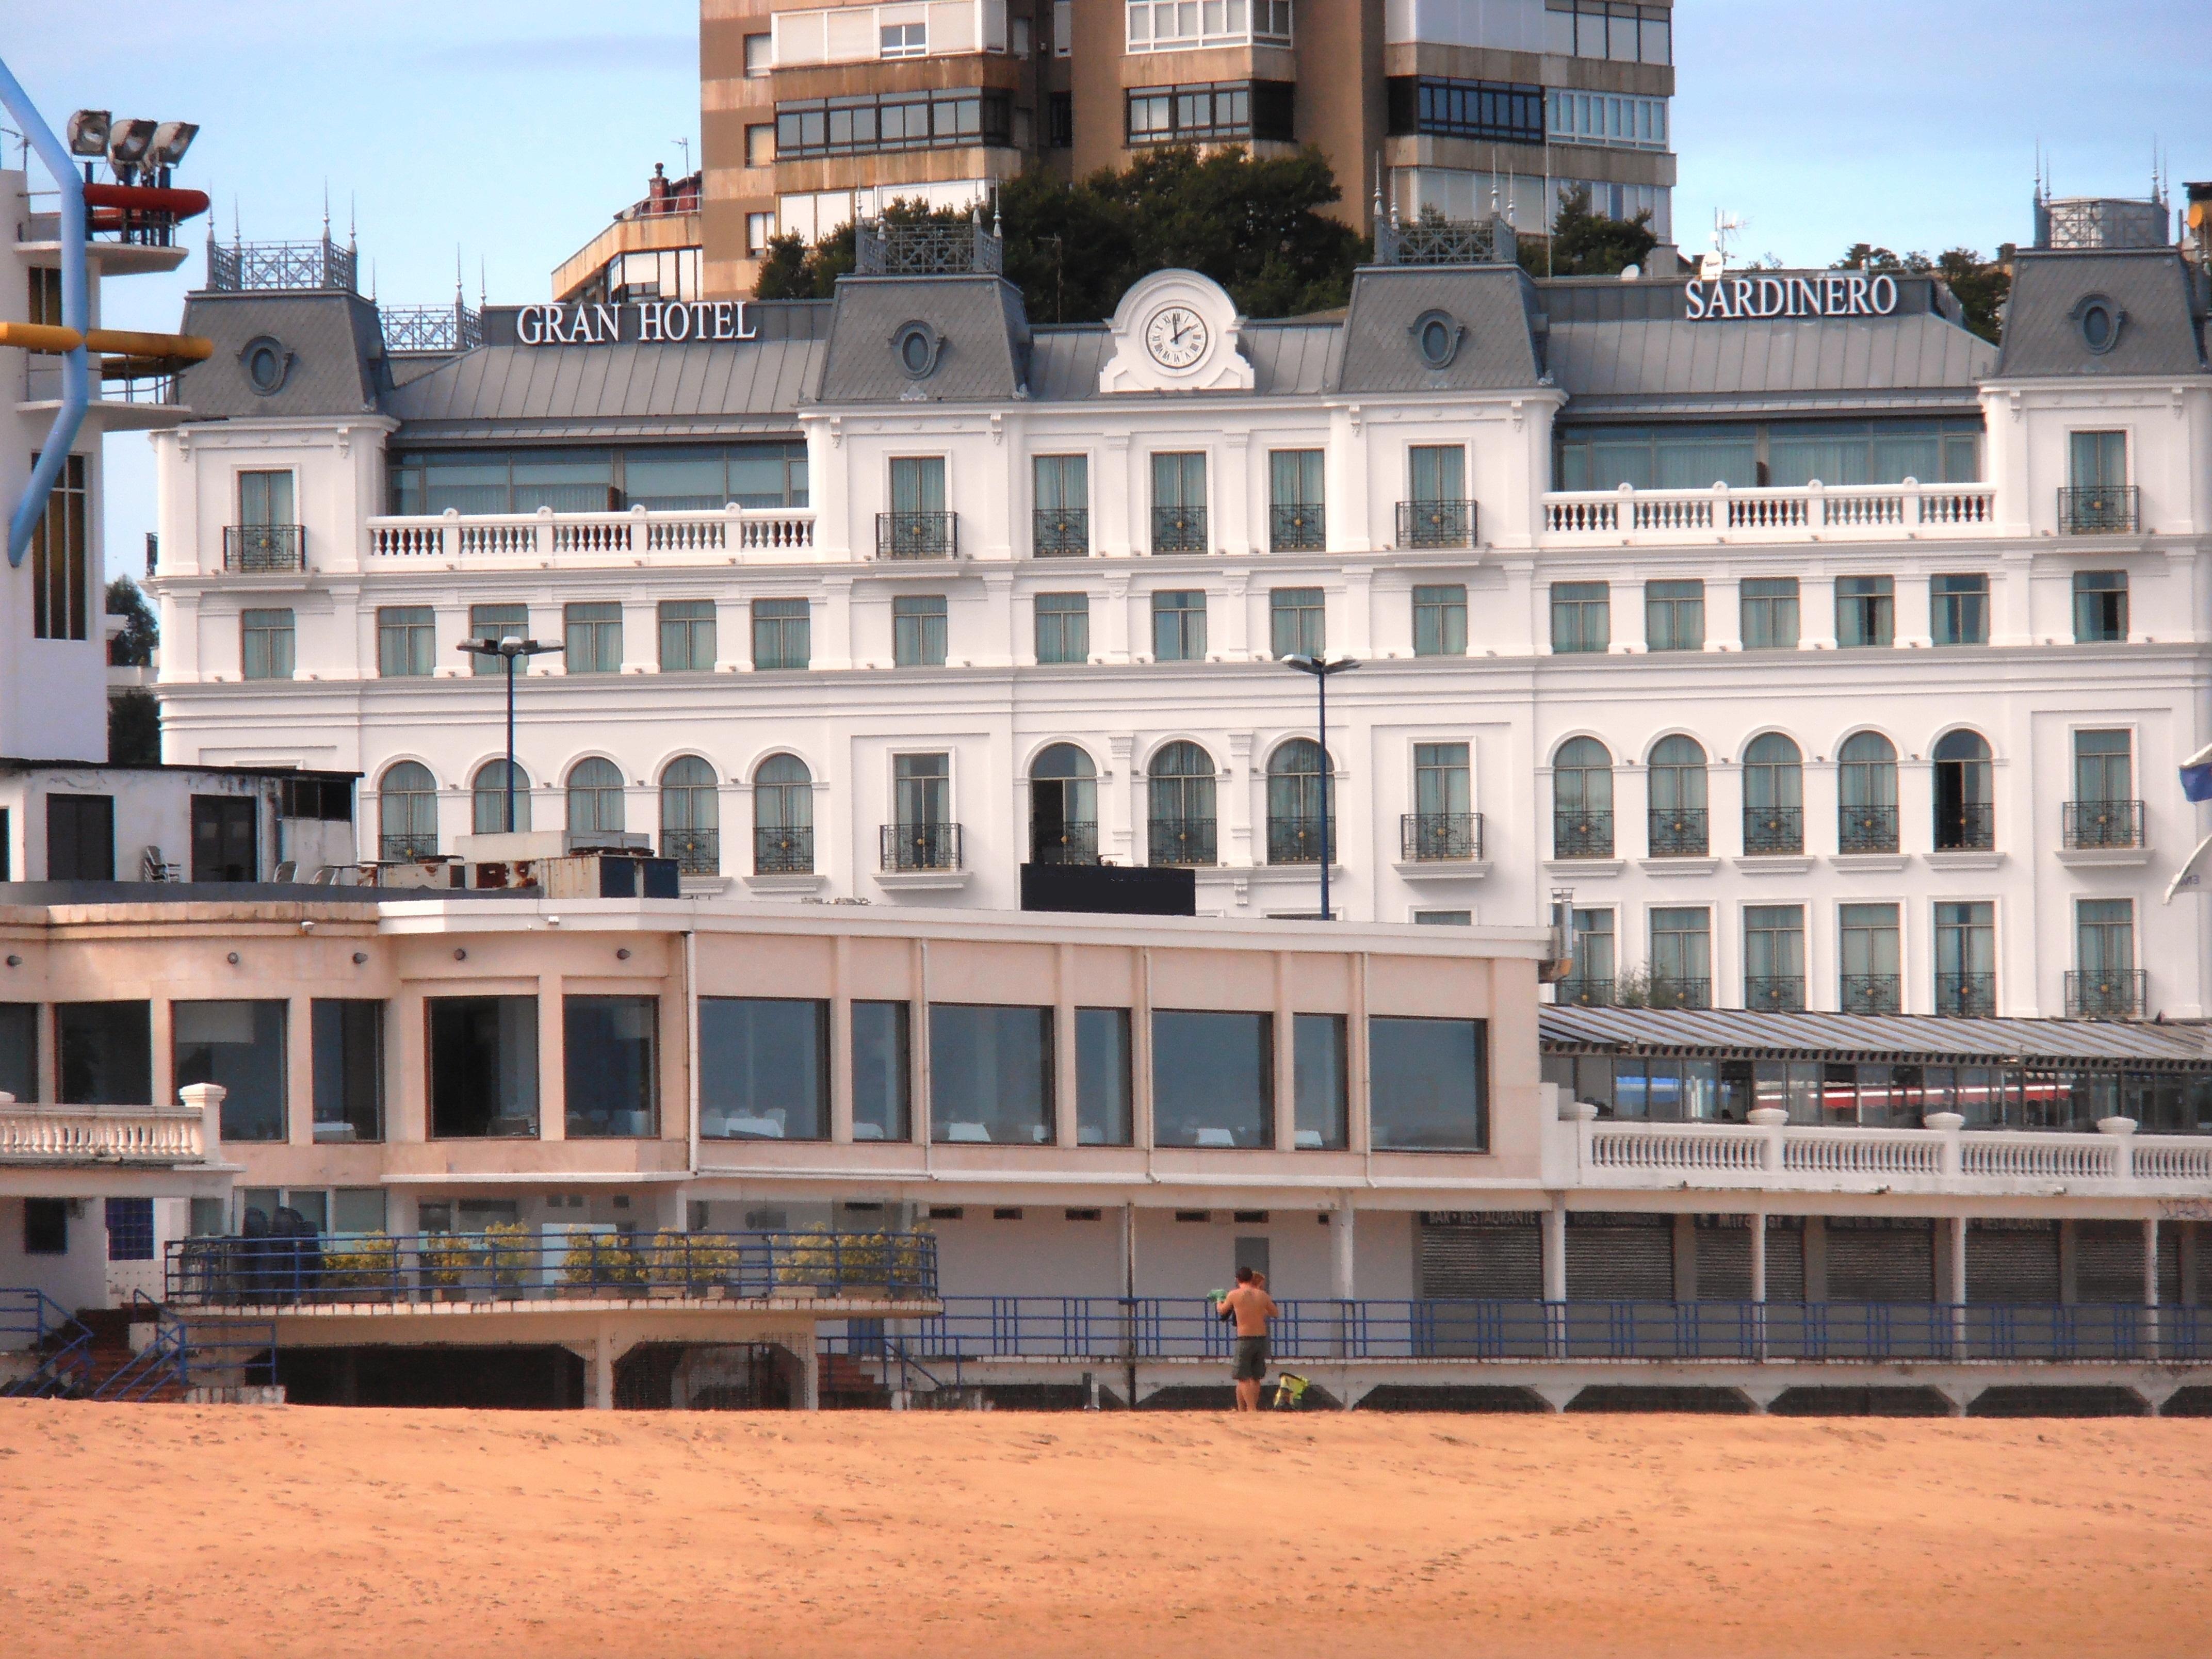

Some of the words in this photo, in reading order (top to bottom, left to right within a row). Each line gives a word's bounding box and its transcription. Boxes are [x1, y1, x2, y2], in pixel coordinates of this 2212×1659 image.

[1685, 274, 1897, 319] SARDINERO
[517, 303, 621, 345] GRAN
[638, 301, 757, 341] HOTEL
